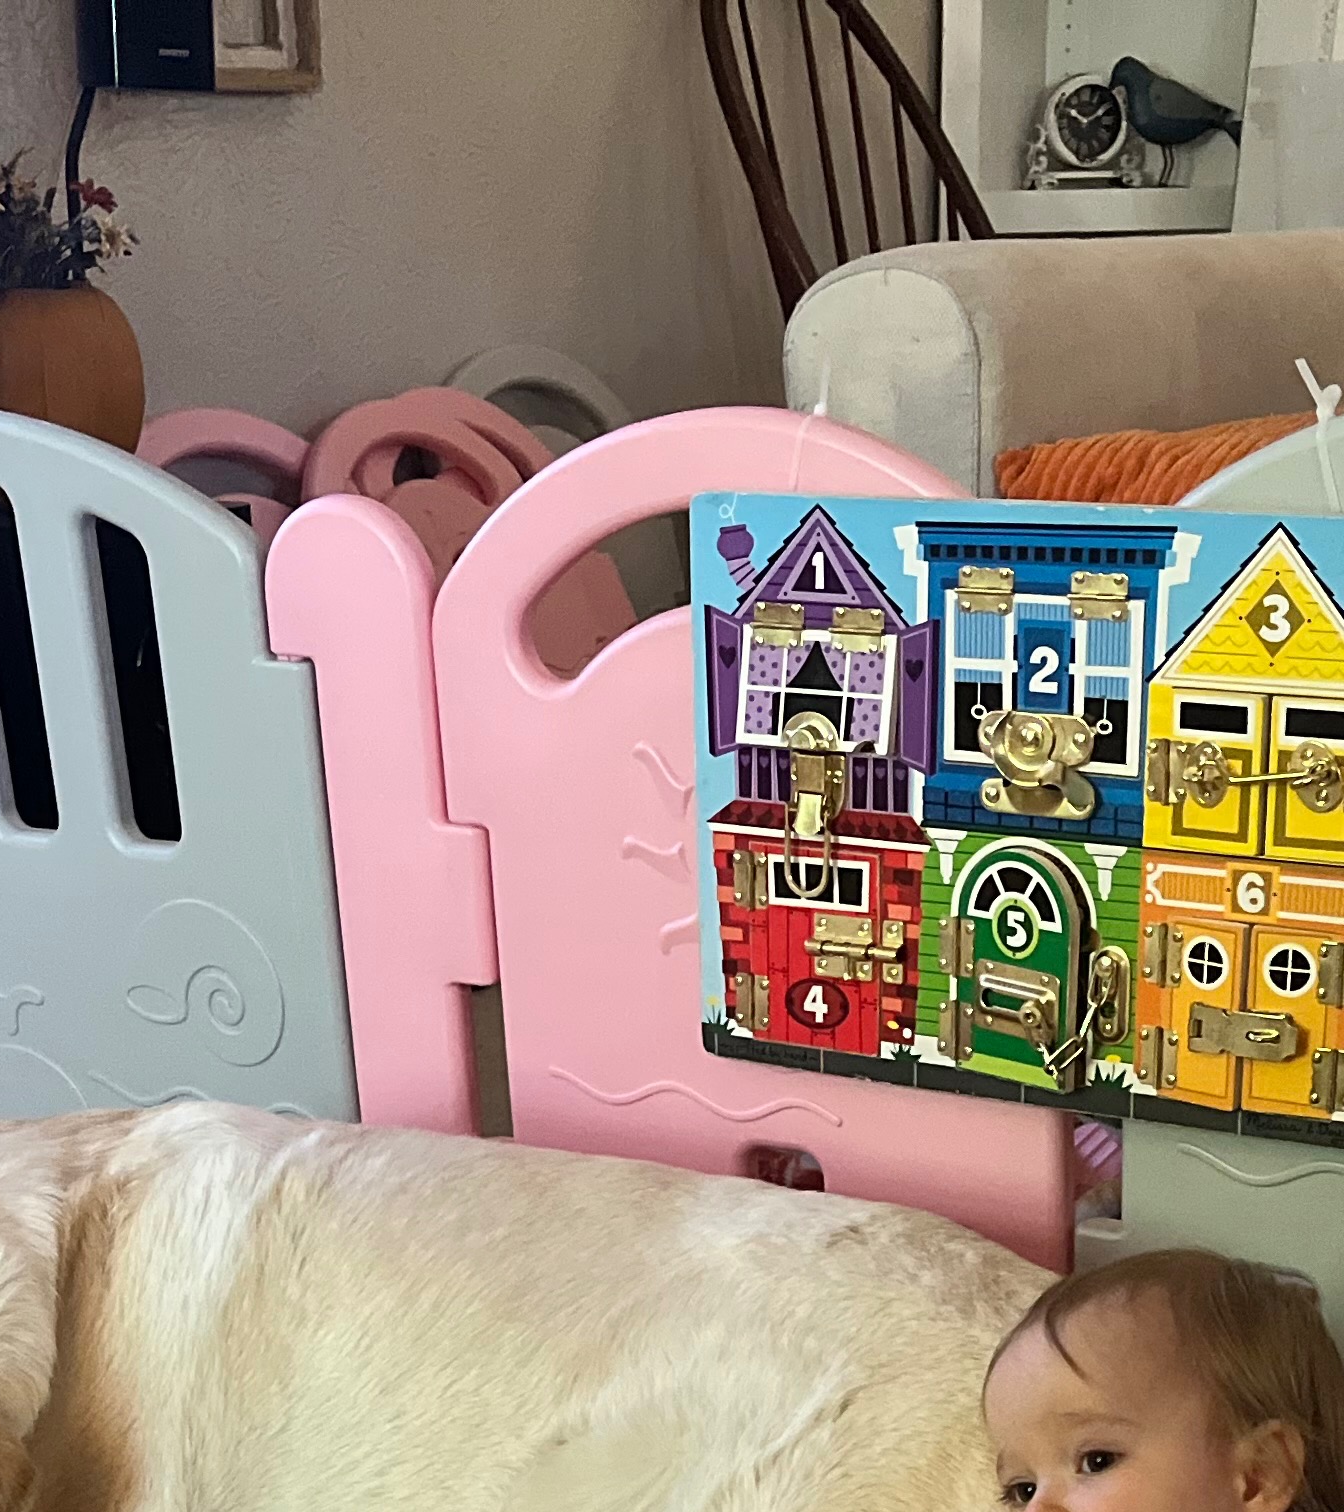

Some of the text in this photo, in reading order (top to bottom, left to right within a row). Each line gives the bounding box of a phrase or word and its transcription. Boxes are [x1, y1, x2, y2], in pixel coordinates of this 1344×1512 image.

[812, 552, 826, 590] 1
[1259, 594, 1290, 642] 3
[1029, 646, 1059, 694] 2
[1237, 873, 1266, 913] 6
[1006, 911, 1027, 948] 5
[803, 988, 829, 1023] 4
